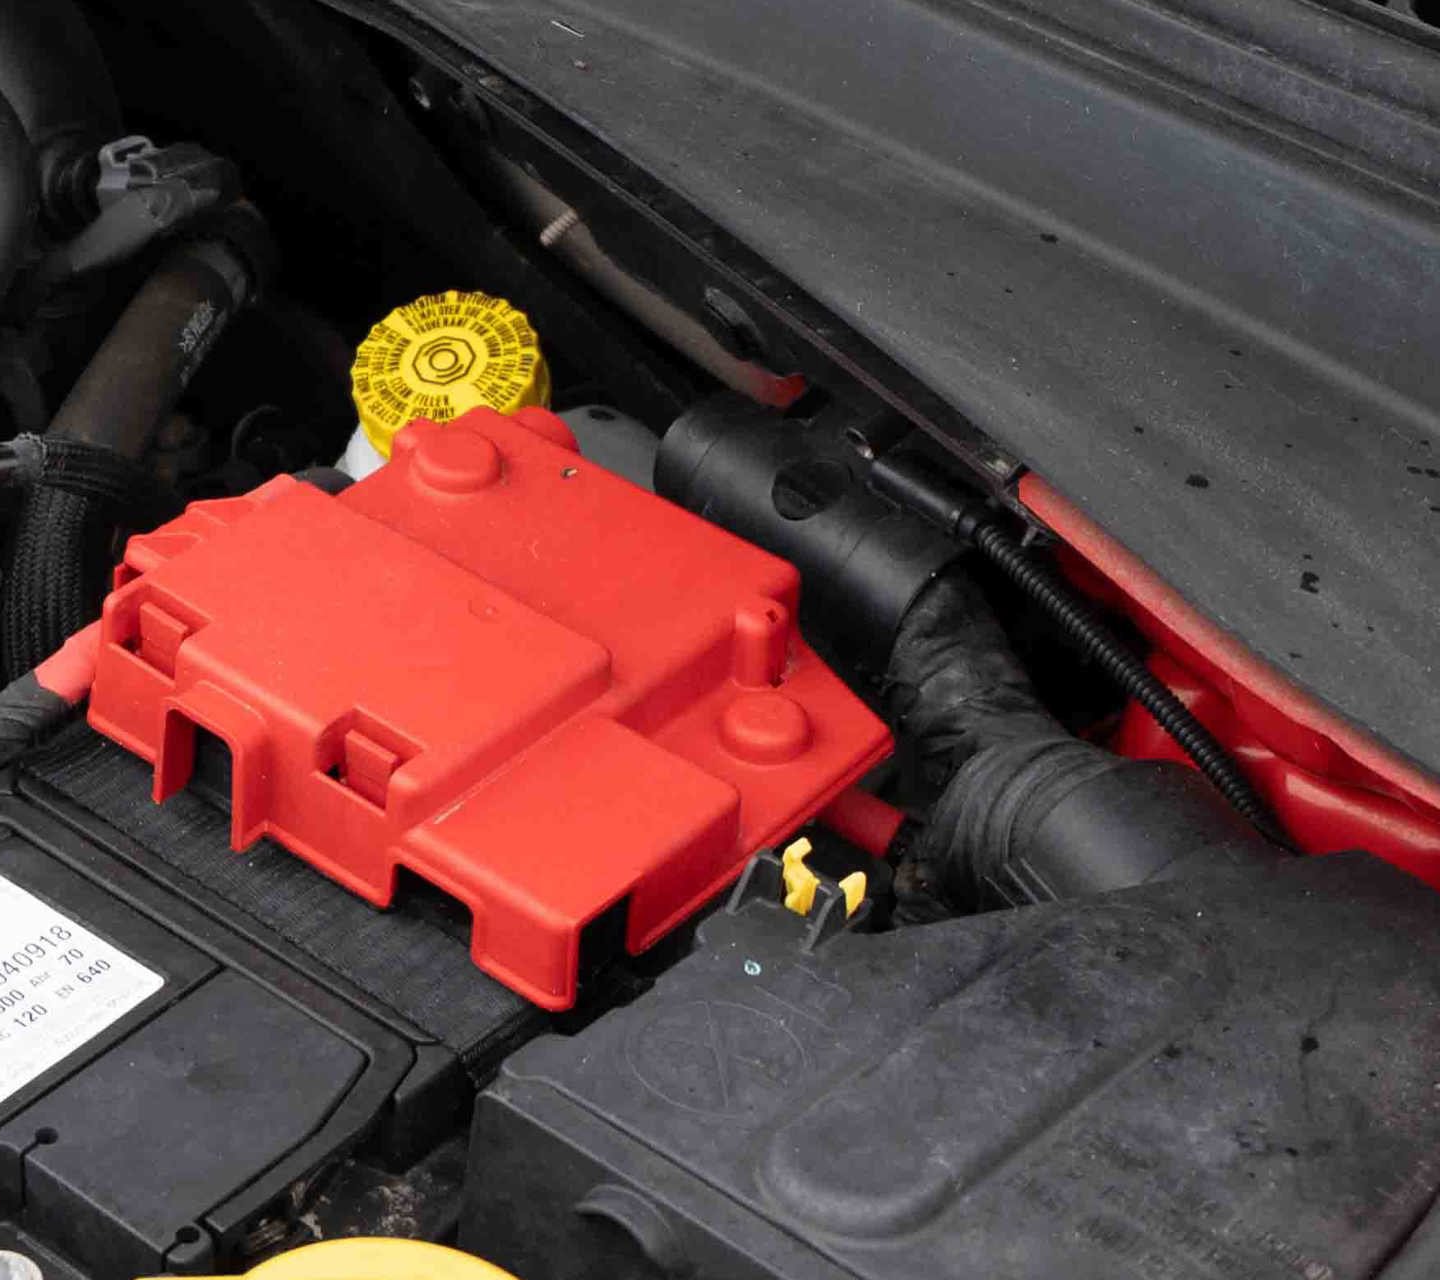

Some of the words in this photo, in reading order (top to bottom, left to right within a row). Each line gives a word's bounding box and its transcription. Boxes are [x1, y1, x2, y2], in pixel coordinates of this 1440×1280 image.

[414, 393, 449, 407] FILLER
[57, 947, 85, 967] 70
[12, 1003, 49, 1029] 120
[75, 957, 113, 985] 640
